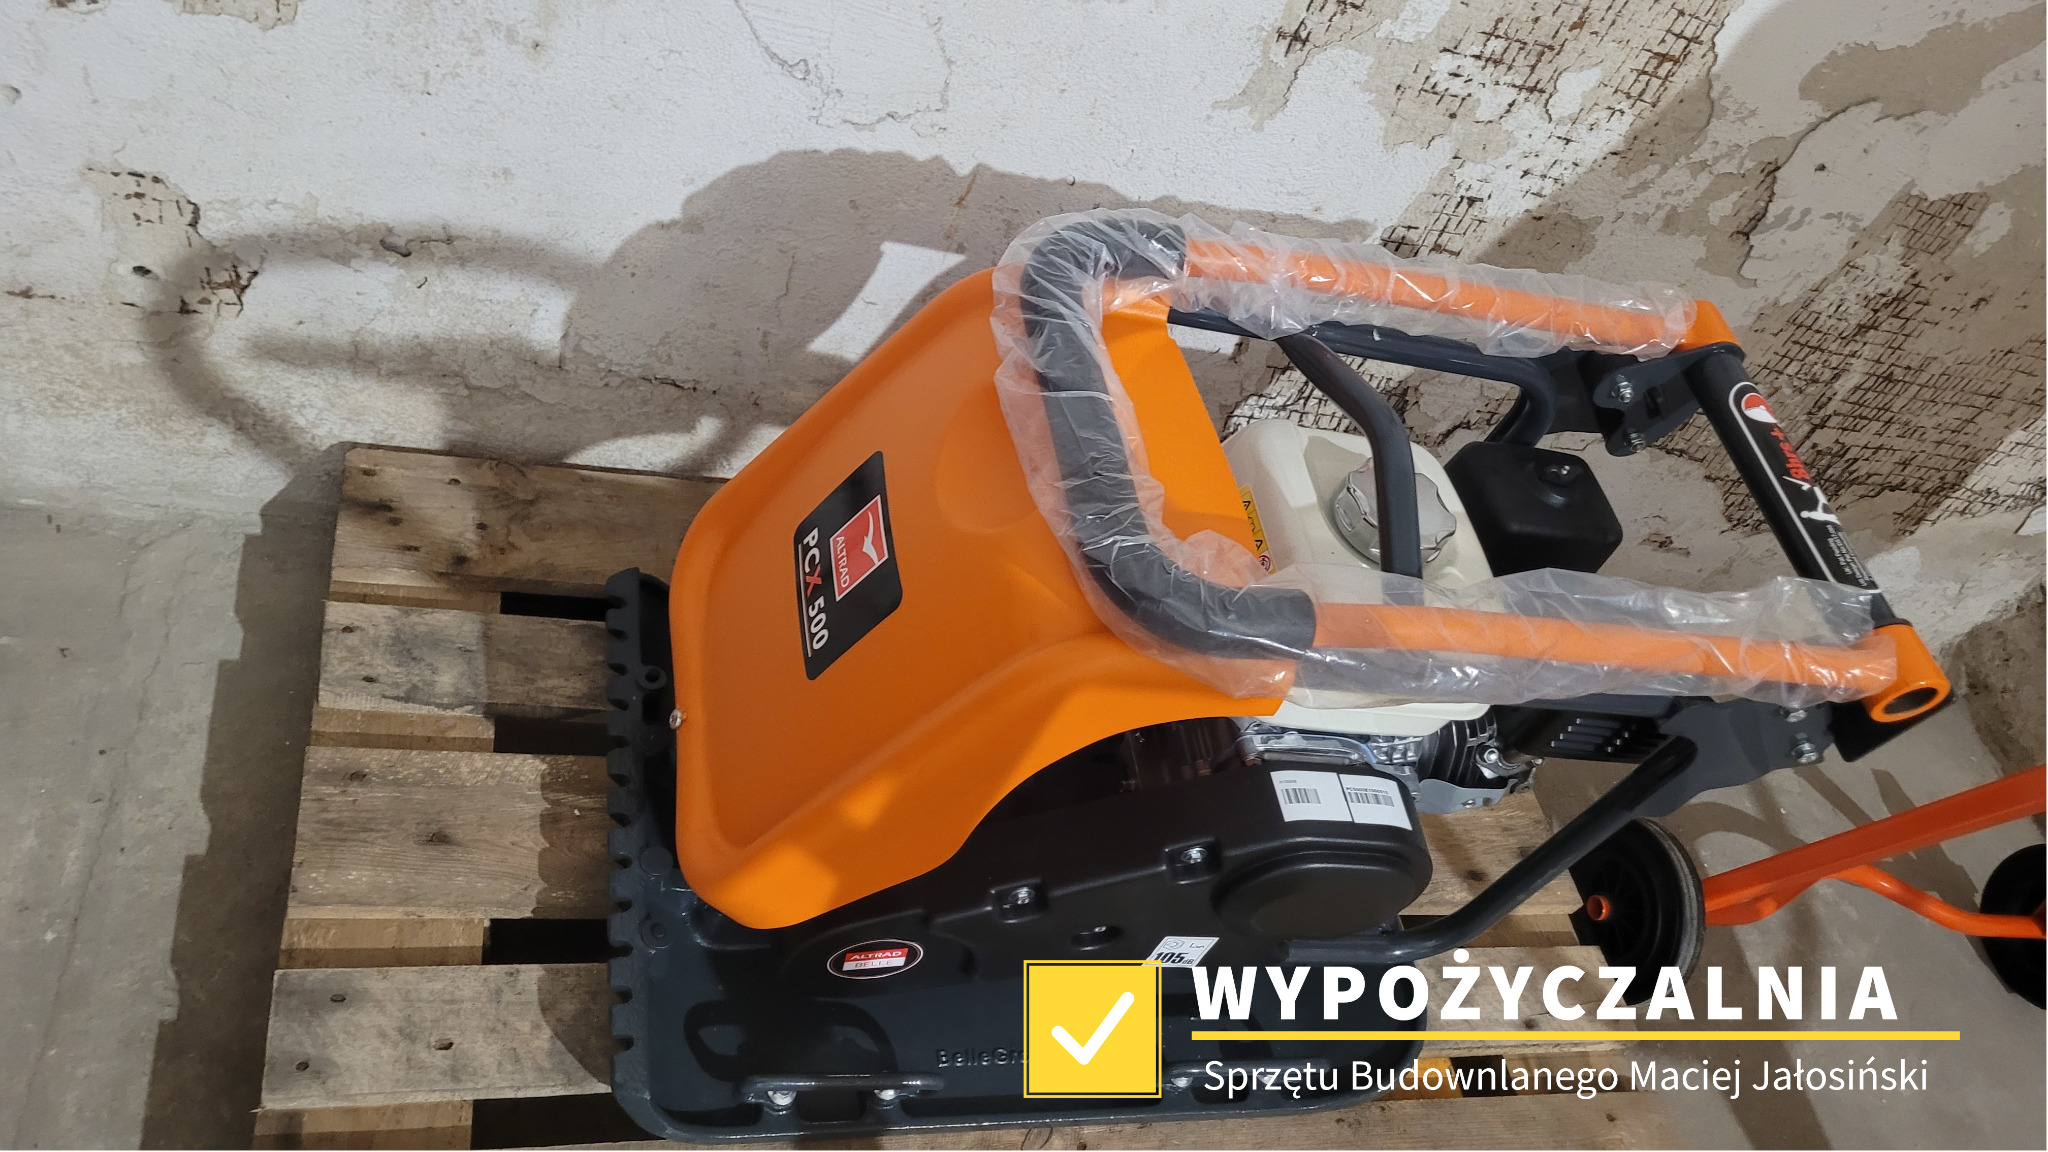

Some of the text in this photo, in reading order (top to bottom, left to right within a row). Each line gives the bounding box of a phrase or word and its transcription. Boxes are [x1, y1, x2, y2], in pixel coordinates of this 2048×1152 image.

[835, 536, 850, 588] ALTRAD
[802, 527, 829, 650] PCX 500
[850, 950, 903, 960] ALTRAD
[1154, 951, 1190, 965] 105
[854, 959, 893, 968] BELLE
